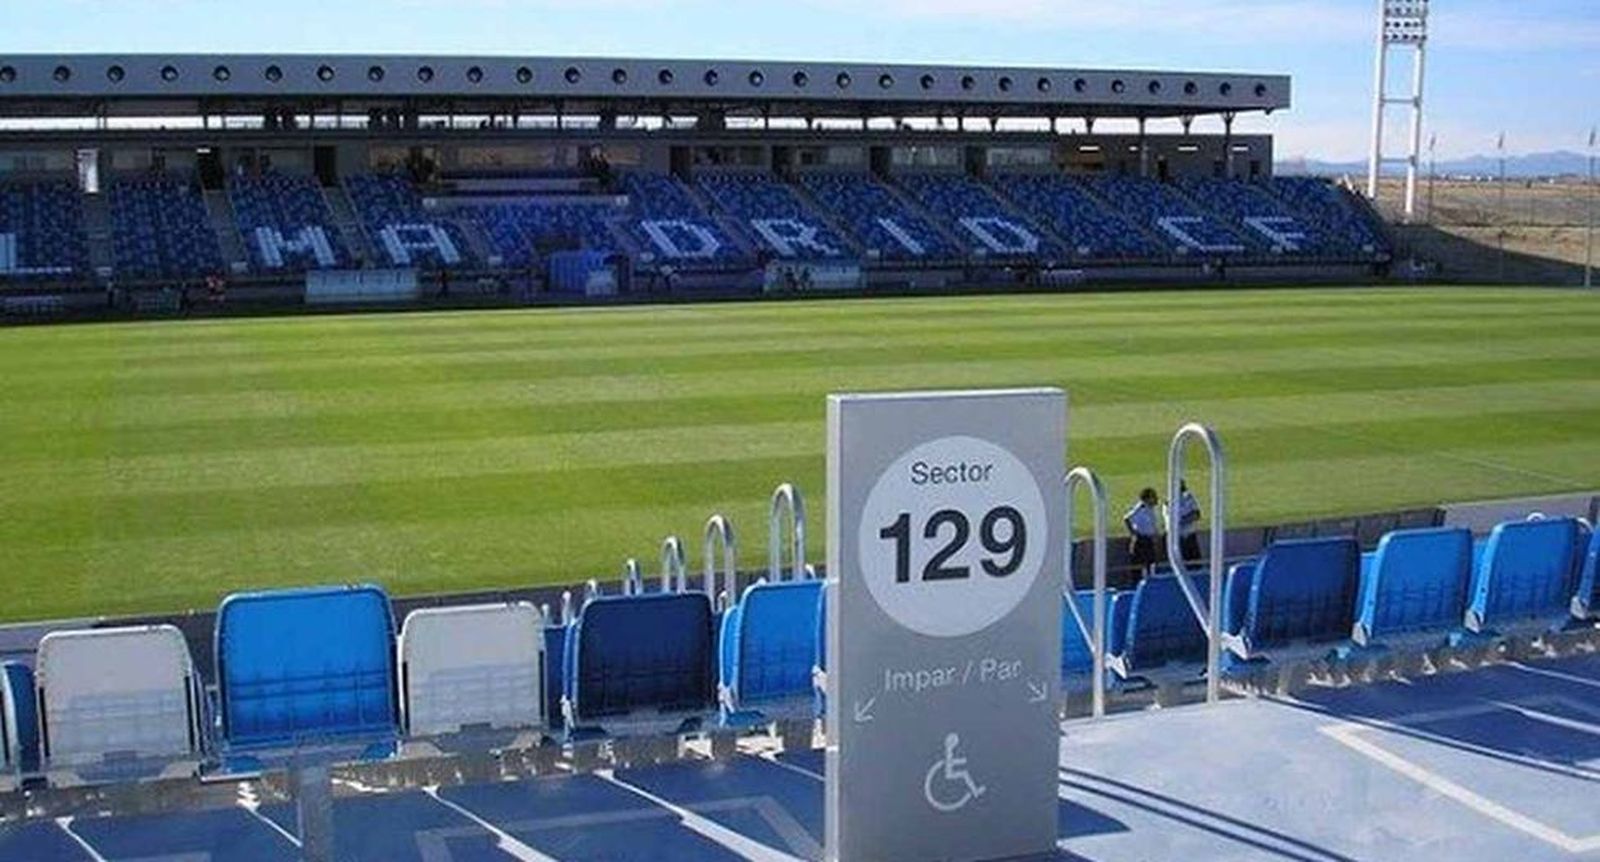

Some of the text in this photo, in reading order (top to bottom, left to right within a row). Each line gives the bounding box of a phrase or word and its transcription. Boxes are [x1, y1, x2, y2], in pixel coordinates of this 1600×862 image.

[255, 216, 1040, 268] MADRID
[1157, 216, 1306, 251] CF
[911, 461, 993, 484] Sector
[879, 505, 1028, 583] 129
[884, 667, 956, 692] Impar
[980, 658, 1022, 680] Par
